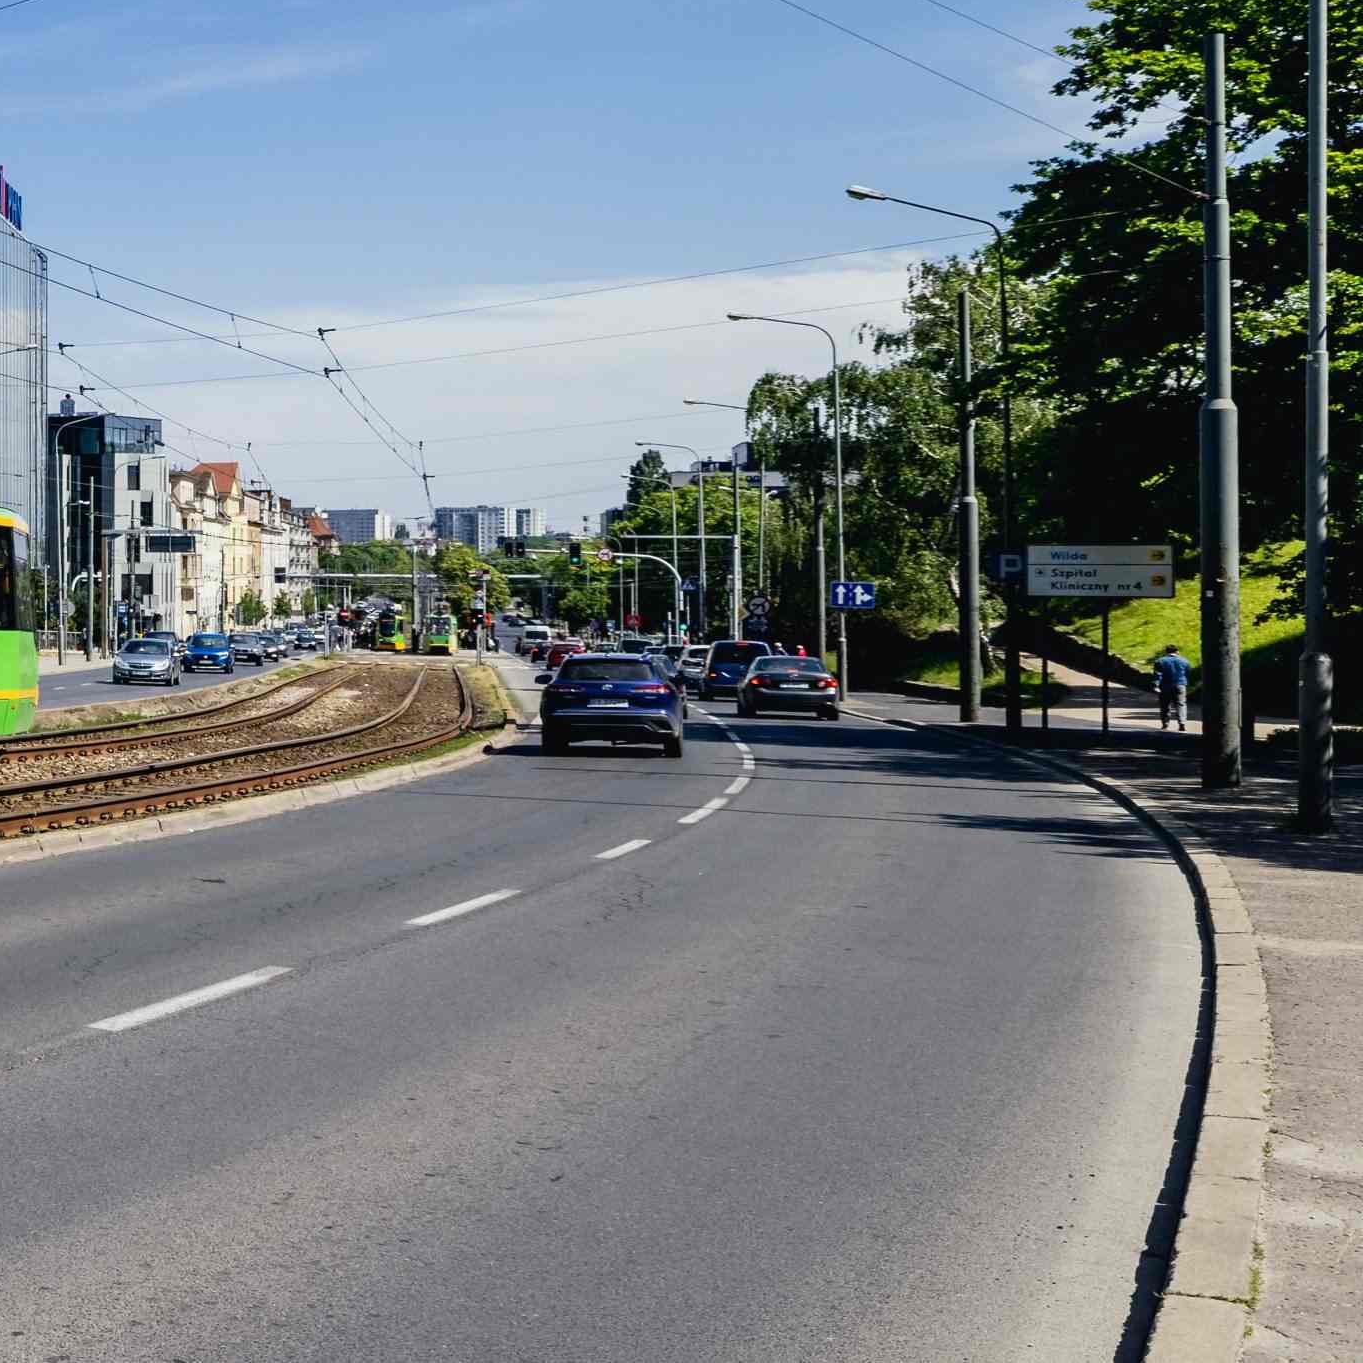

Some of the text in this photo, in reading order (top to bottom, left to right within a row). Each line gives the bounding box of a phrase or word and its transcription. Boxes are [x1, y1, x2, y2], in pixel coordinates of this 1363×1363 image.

[1050, 568, 1097, 579] Szpital
[1050, 581, 1110, 593] Kliniczny
[1134, 581, 1143, 591] 4
